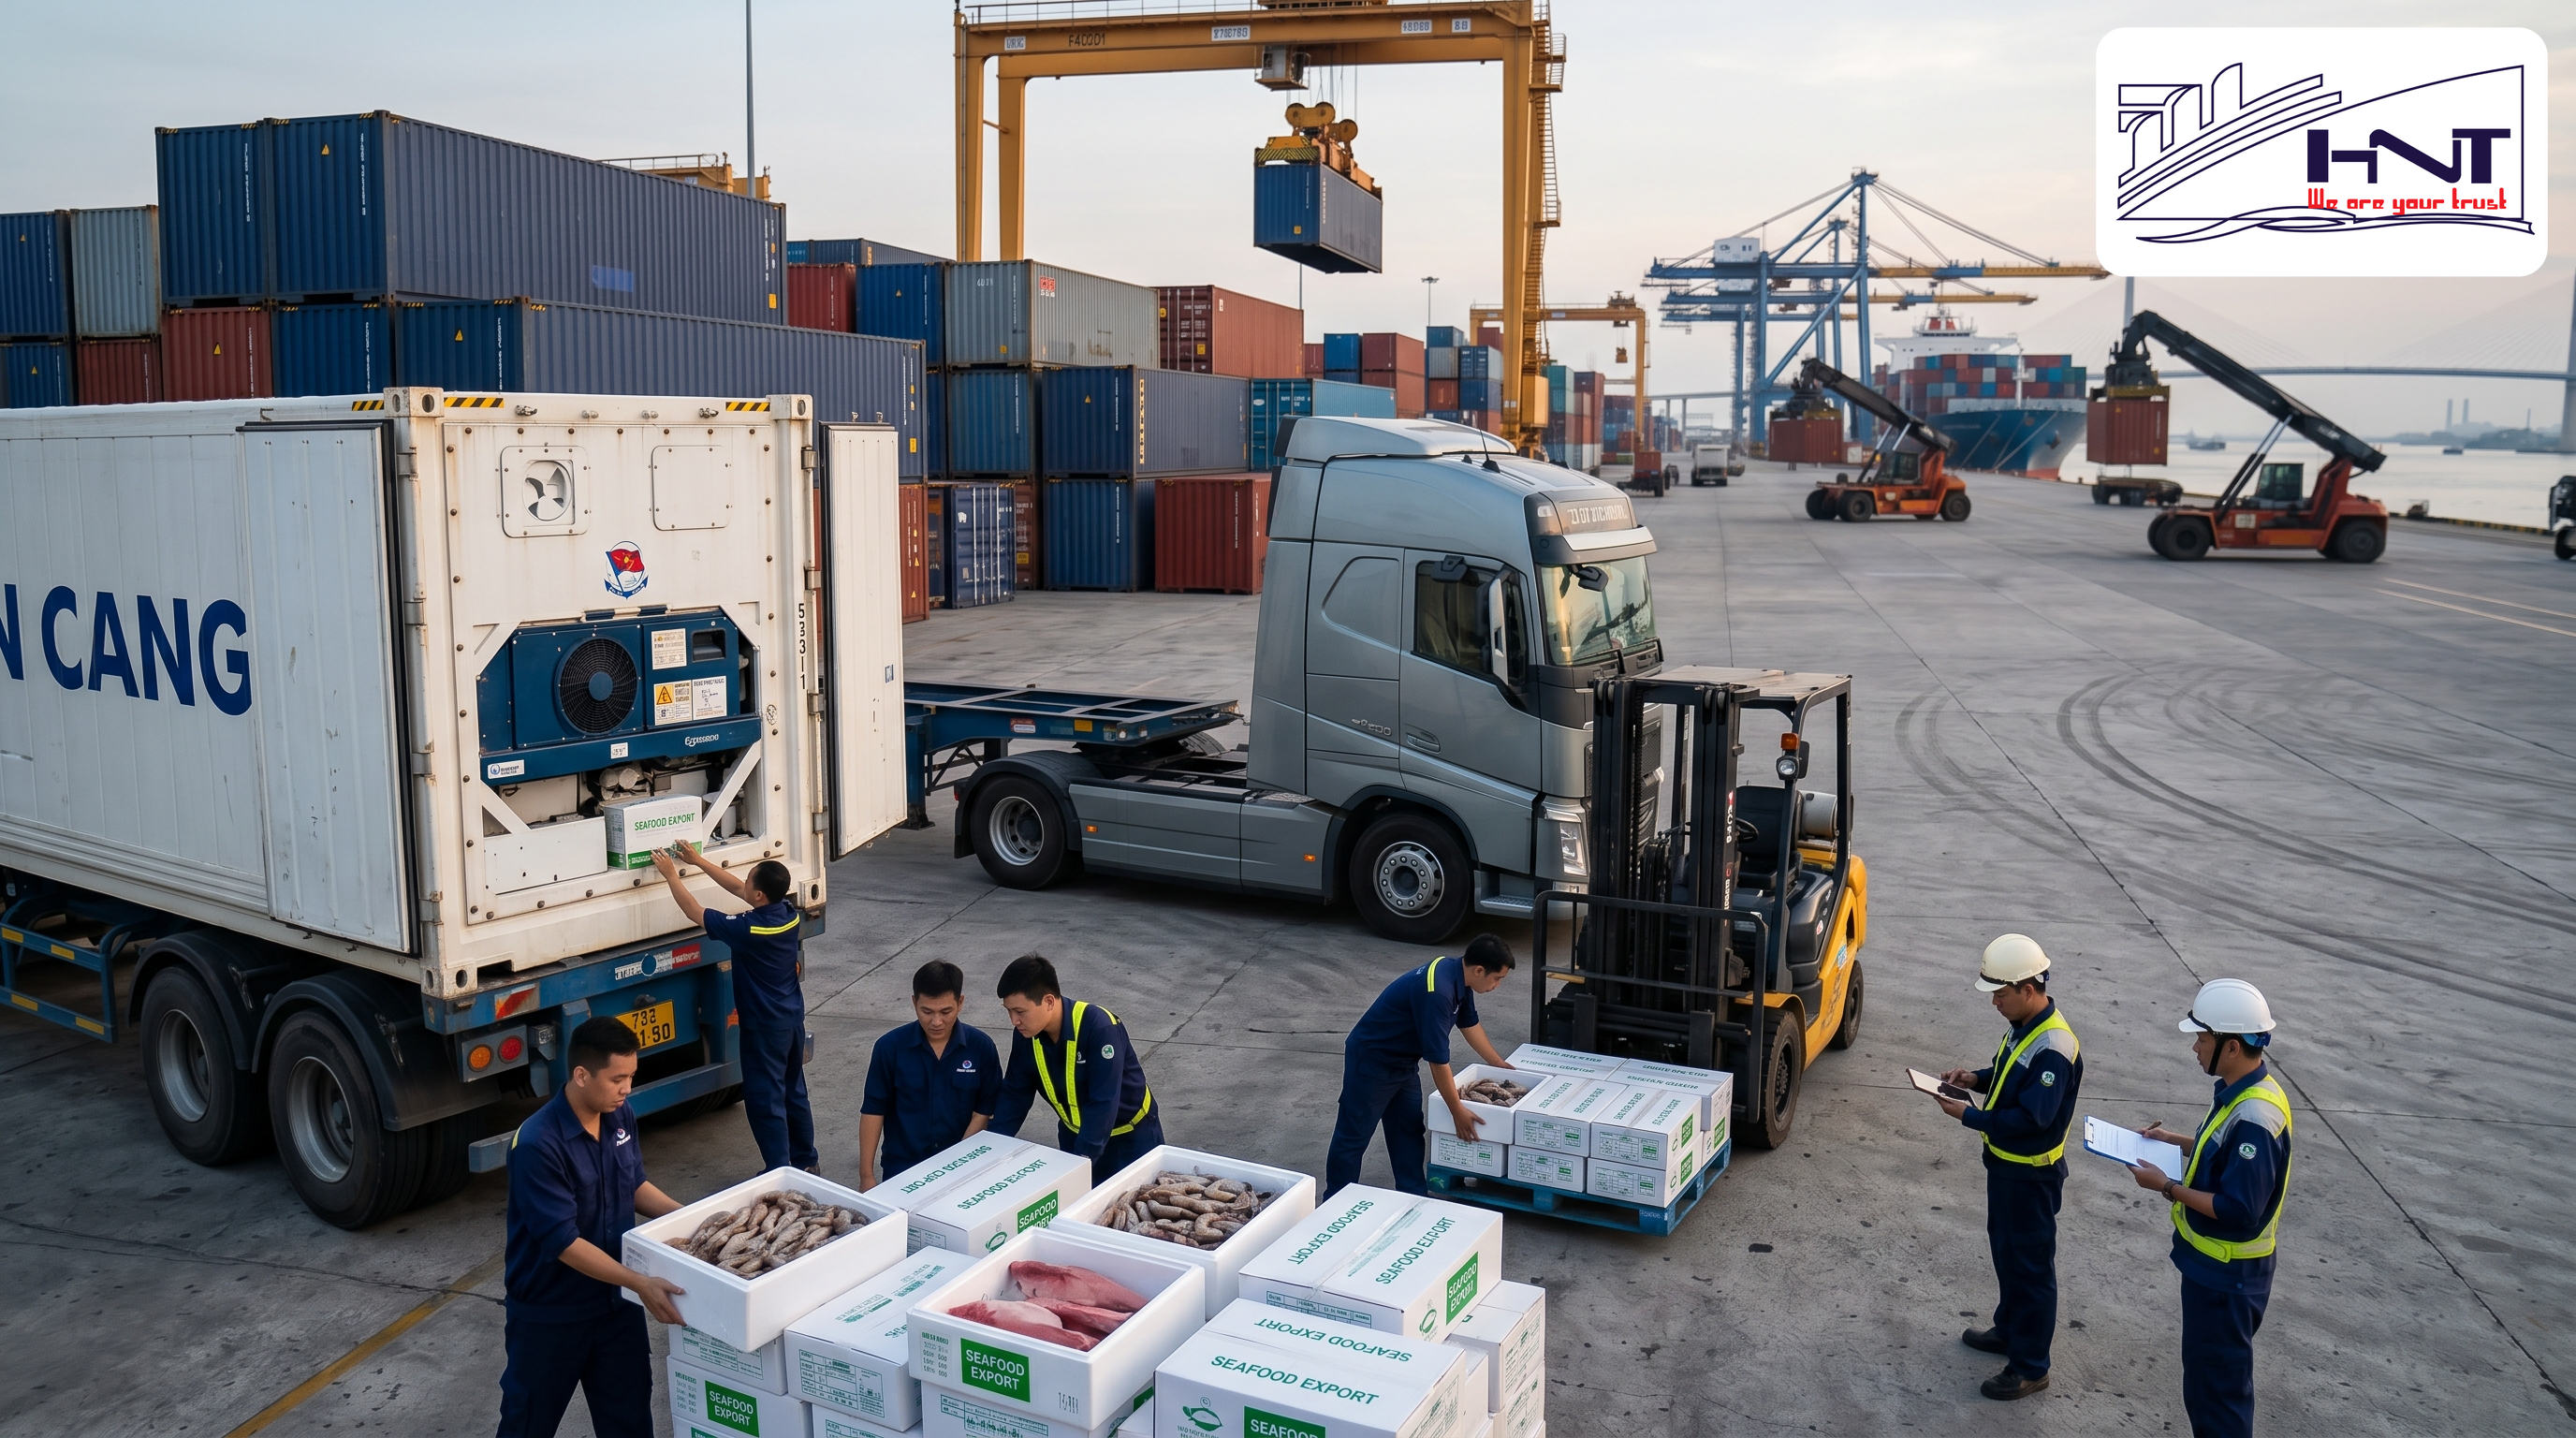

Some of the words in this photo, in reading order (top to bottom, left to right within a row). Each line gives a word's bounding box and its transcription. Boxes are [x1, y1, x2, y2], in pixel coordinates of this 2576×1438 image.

[41, 585, 252, 716] CANG
[635, 817, 666, 831] SEAFOOD
[1254, 1318, 1326, 1341] EXPORT
[1327, 1335, 1412, 1363] SEAFOOD
[965, 1349, 1025, 1376] SEAFOOD
[971, 1366, 1019, 1390] EXPORT
[1210, 1356, 1298, 1385] SEAFOOD
[1299, 1377, 1379, 1405] EXPORT
[710, 1390, 754, 1415] SEAFOOD
[715, 1404, 751, 1426] EXPORT
